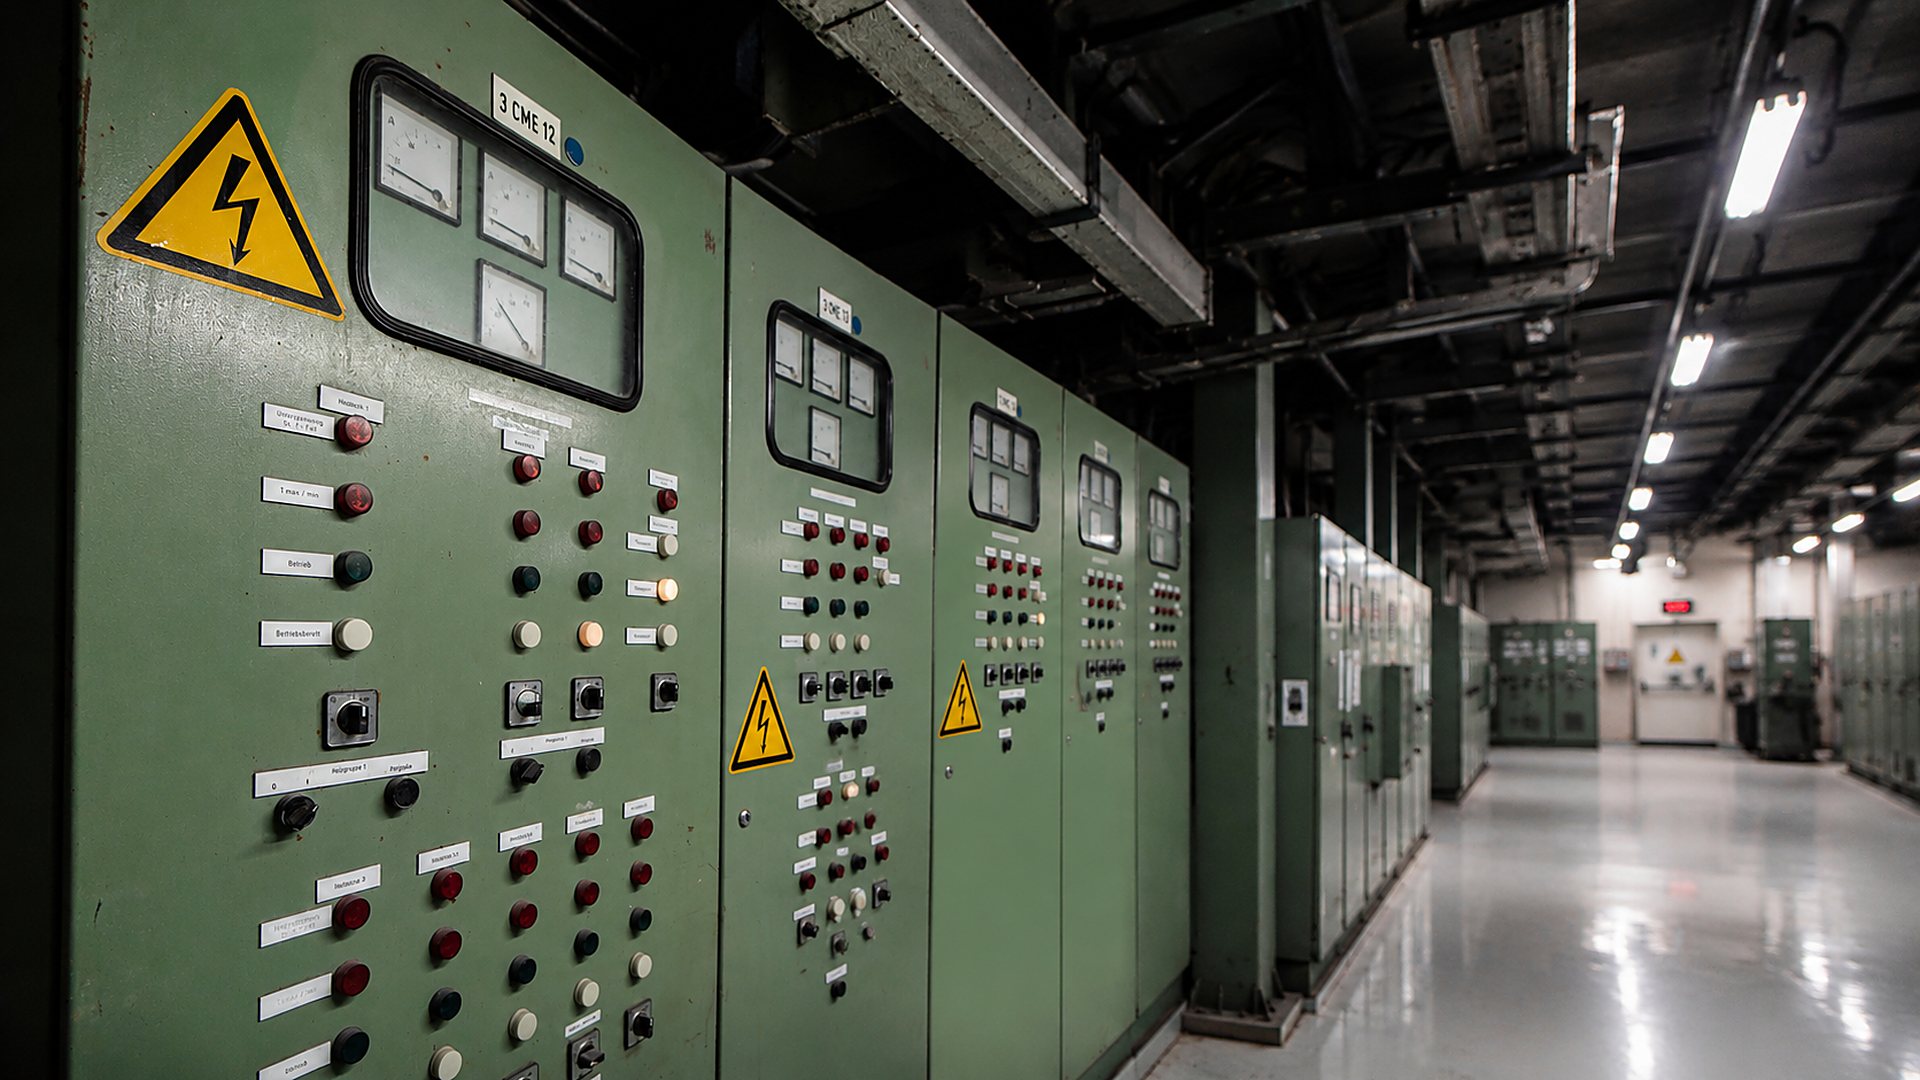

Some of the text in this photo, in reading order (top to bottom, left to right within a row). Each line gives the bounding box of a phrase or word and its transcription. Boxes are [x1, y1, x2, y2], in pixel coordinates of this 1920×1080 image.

[499, 92, 556, 146] 3 CME 12
